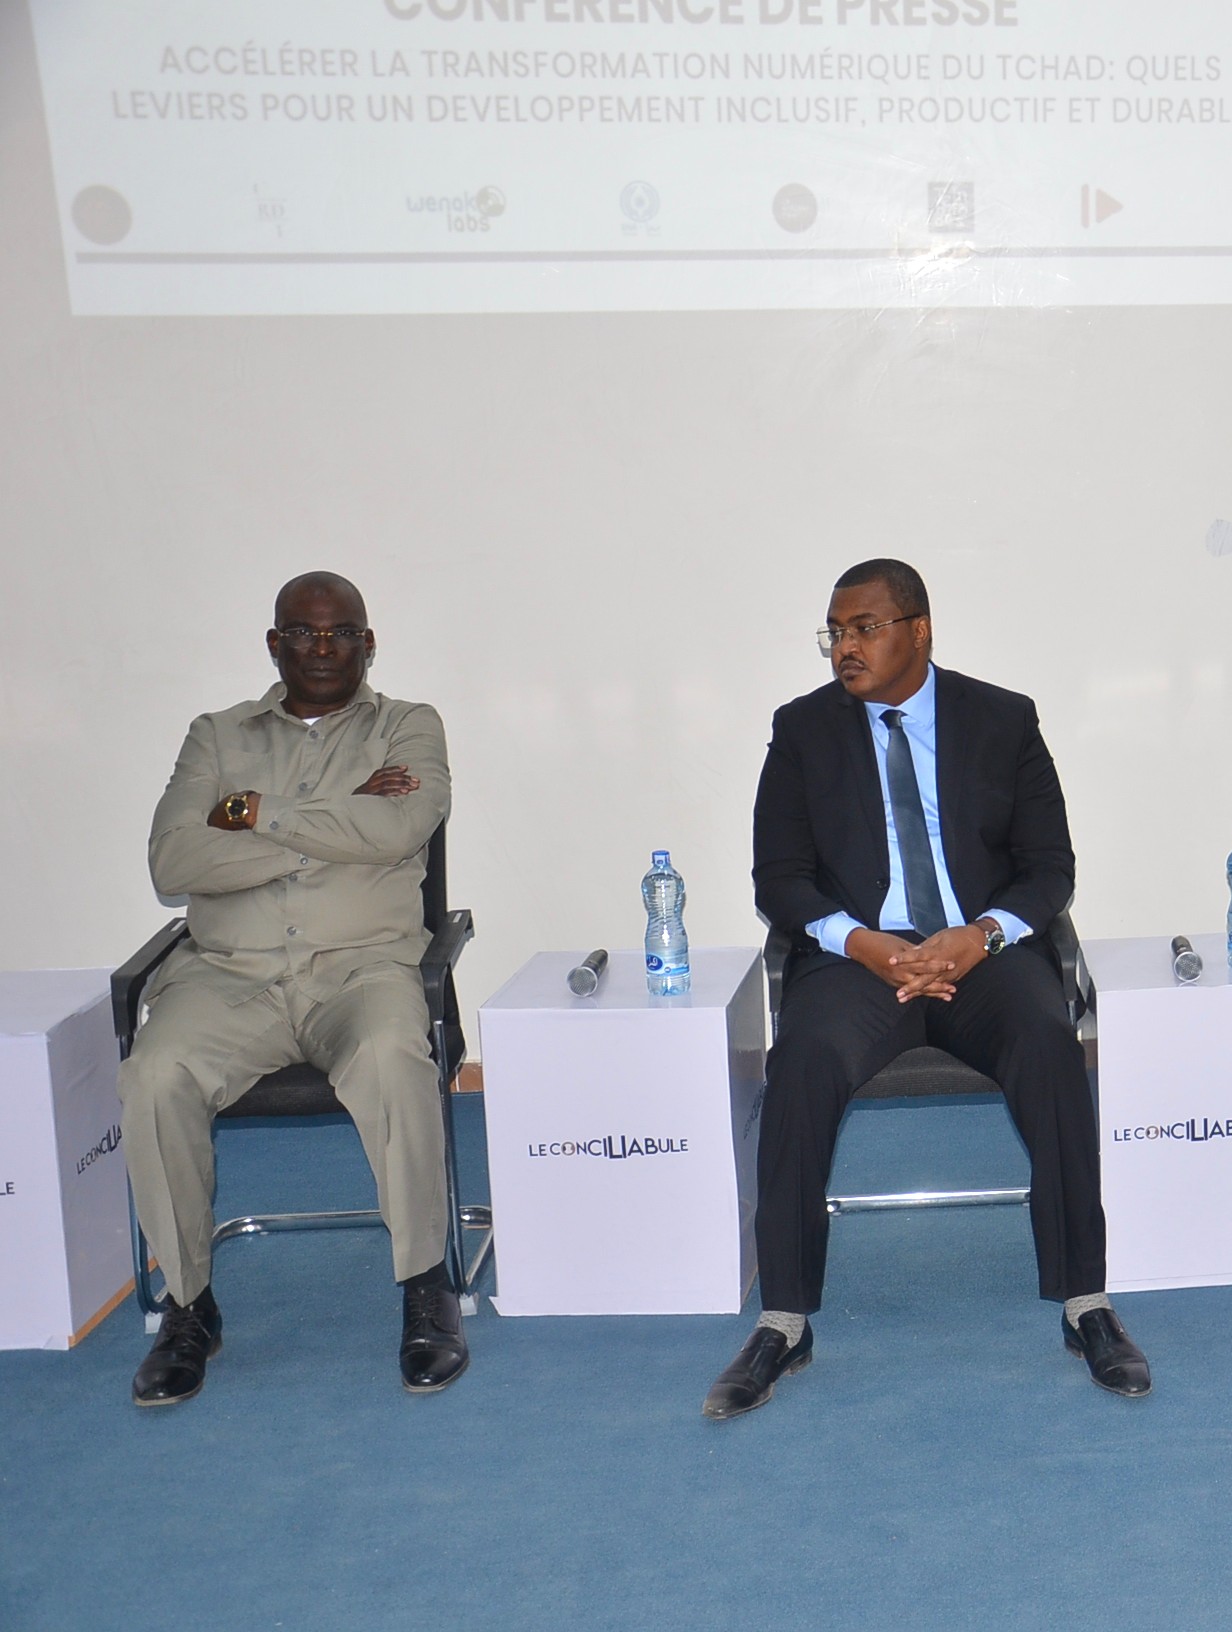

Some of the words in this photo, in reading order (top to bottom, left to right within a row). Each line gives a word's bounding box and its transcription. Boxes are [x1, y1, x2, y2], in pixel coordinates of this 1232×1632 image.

[758, 0, 824, 25] DE
[836, 0, 1019, 27] PRESSE
[159, 40, 359, 78] ACCÉLÉRER
[370, 49, 411, 78] LA
[420, 49, 731, 80] TRANSFORMATION
[742, 46, 931, 85] NUMÉRIQUE
[941, 53, 985, 81] DU
[995, 53, 1115, 81] TCHAD:
[1125, 54, 1222, 85] QUELS
[111, 90, 249, 122] LEVIERS
[260, 93, 356, 123] POUR
[366, 94, 414, 123] UN
[425, 94, 705, 124] DEVELOPPEMENT
[716, 95, 867, 127] INCLUSIF,
[877, 96, 1057, 124] PRODUCTIF
[1068, 96, 1102, 124] ET
[85, 1124, 122, 1166] CONCILIA
